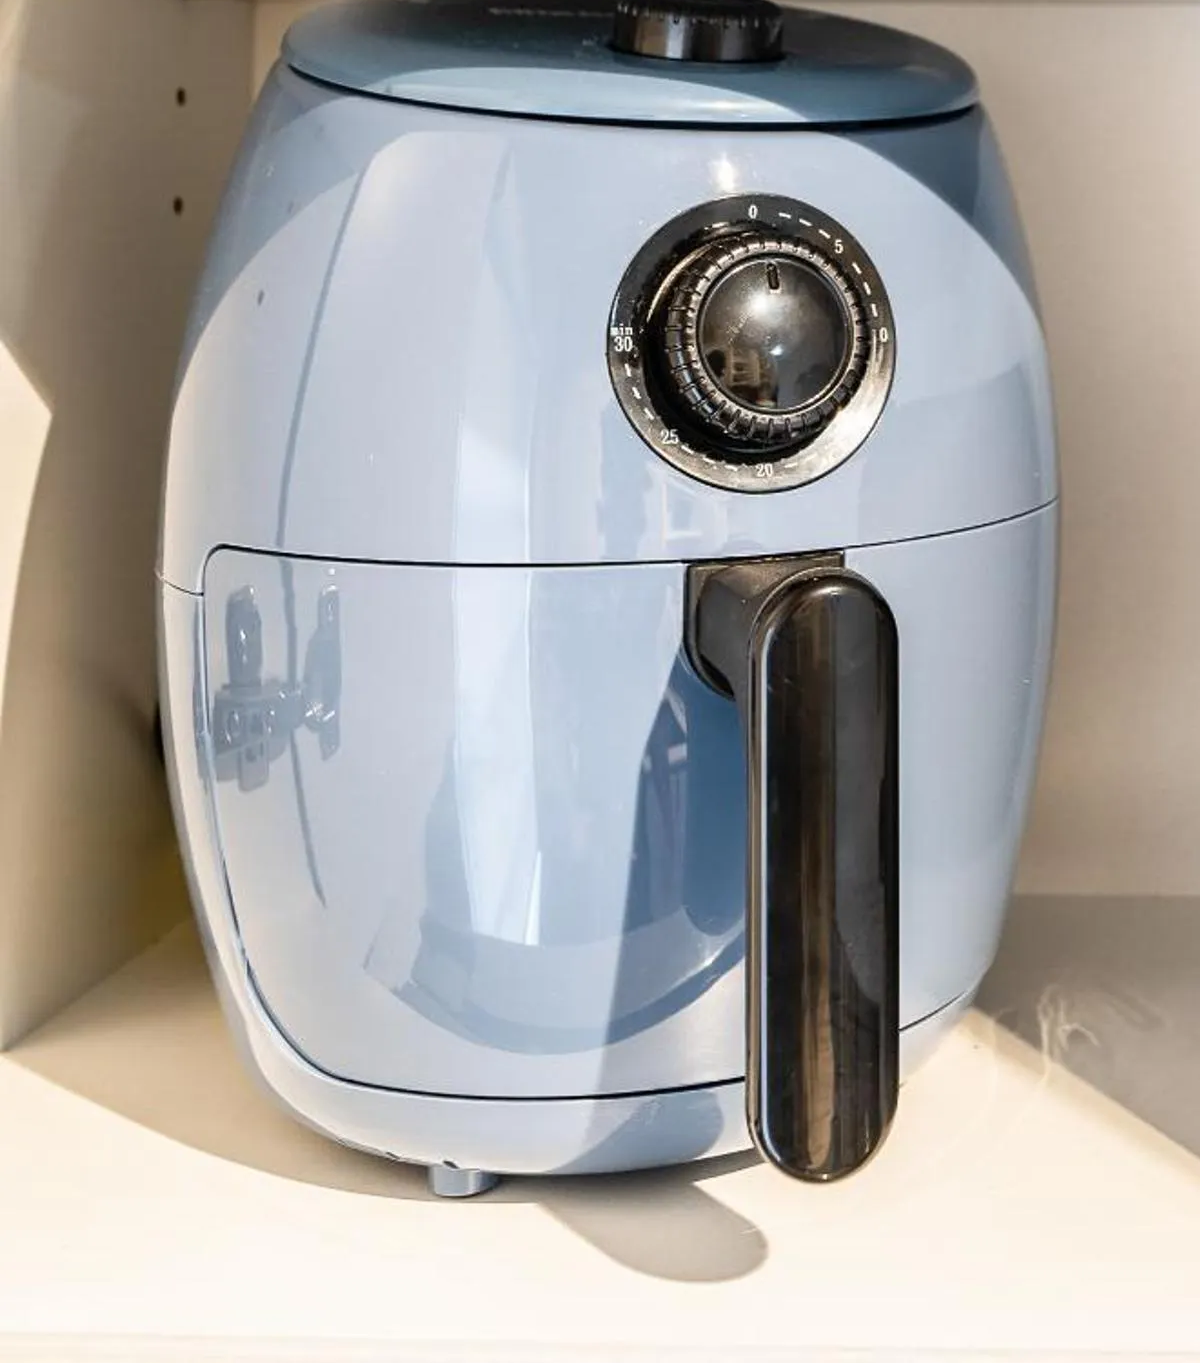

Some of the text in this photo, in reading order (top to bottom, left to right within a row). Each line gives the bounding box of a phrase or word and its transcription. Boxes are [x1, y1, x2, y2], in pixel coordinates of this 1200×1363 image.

[748, 205, 758, 219] 0
[835, 240, 844, 253] 5
[610, 323, 633, 336] min
[614, 335, 633, 352] 30
[660, 428, 679, 444] 25
[756, 463, 773, 478] 20
